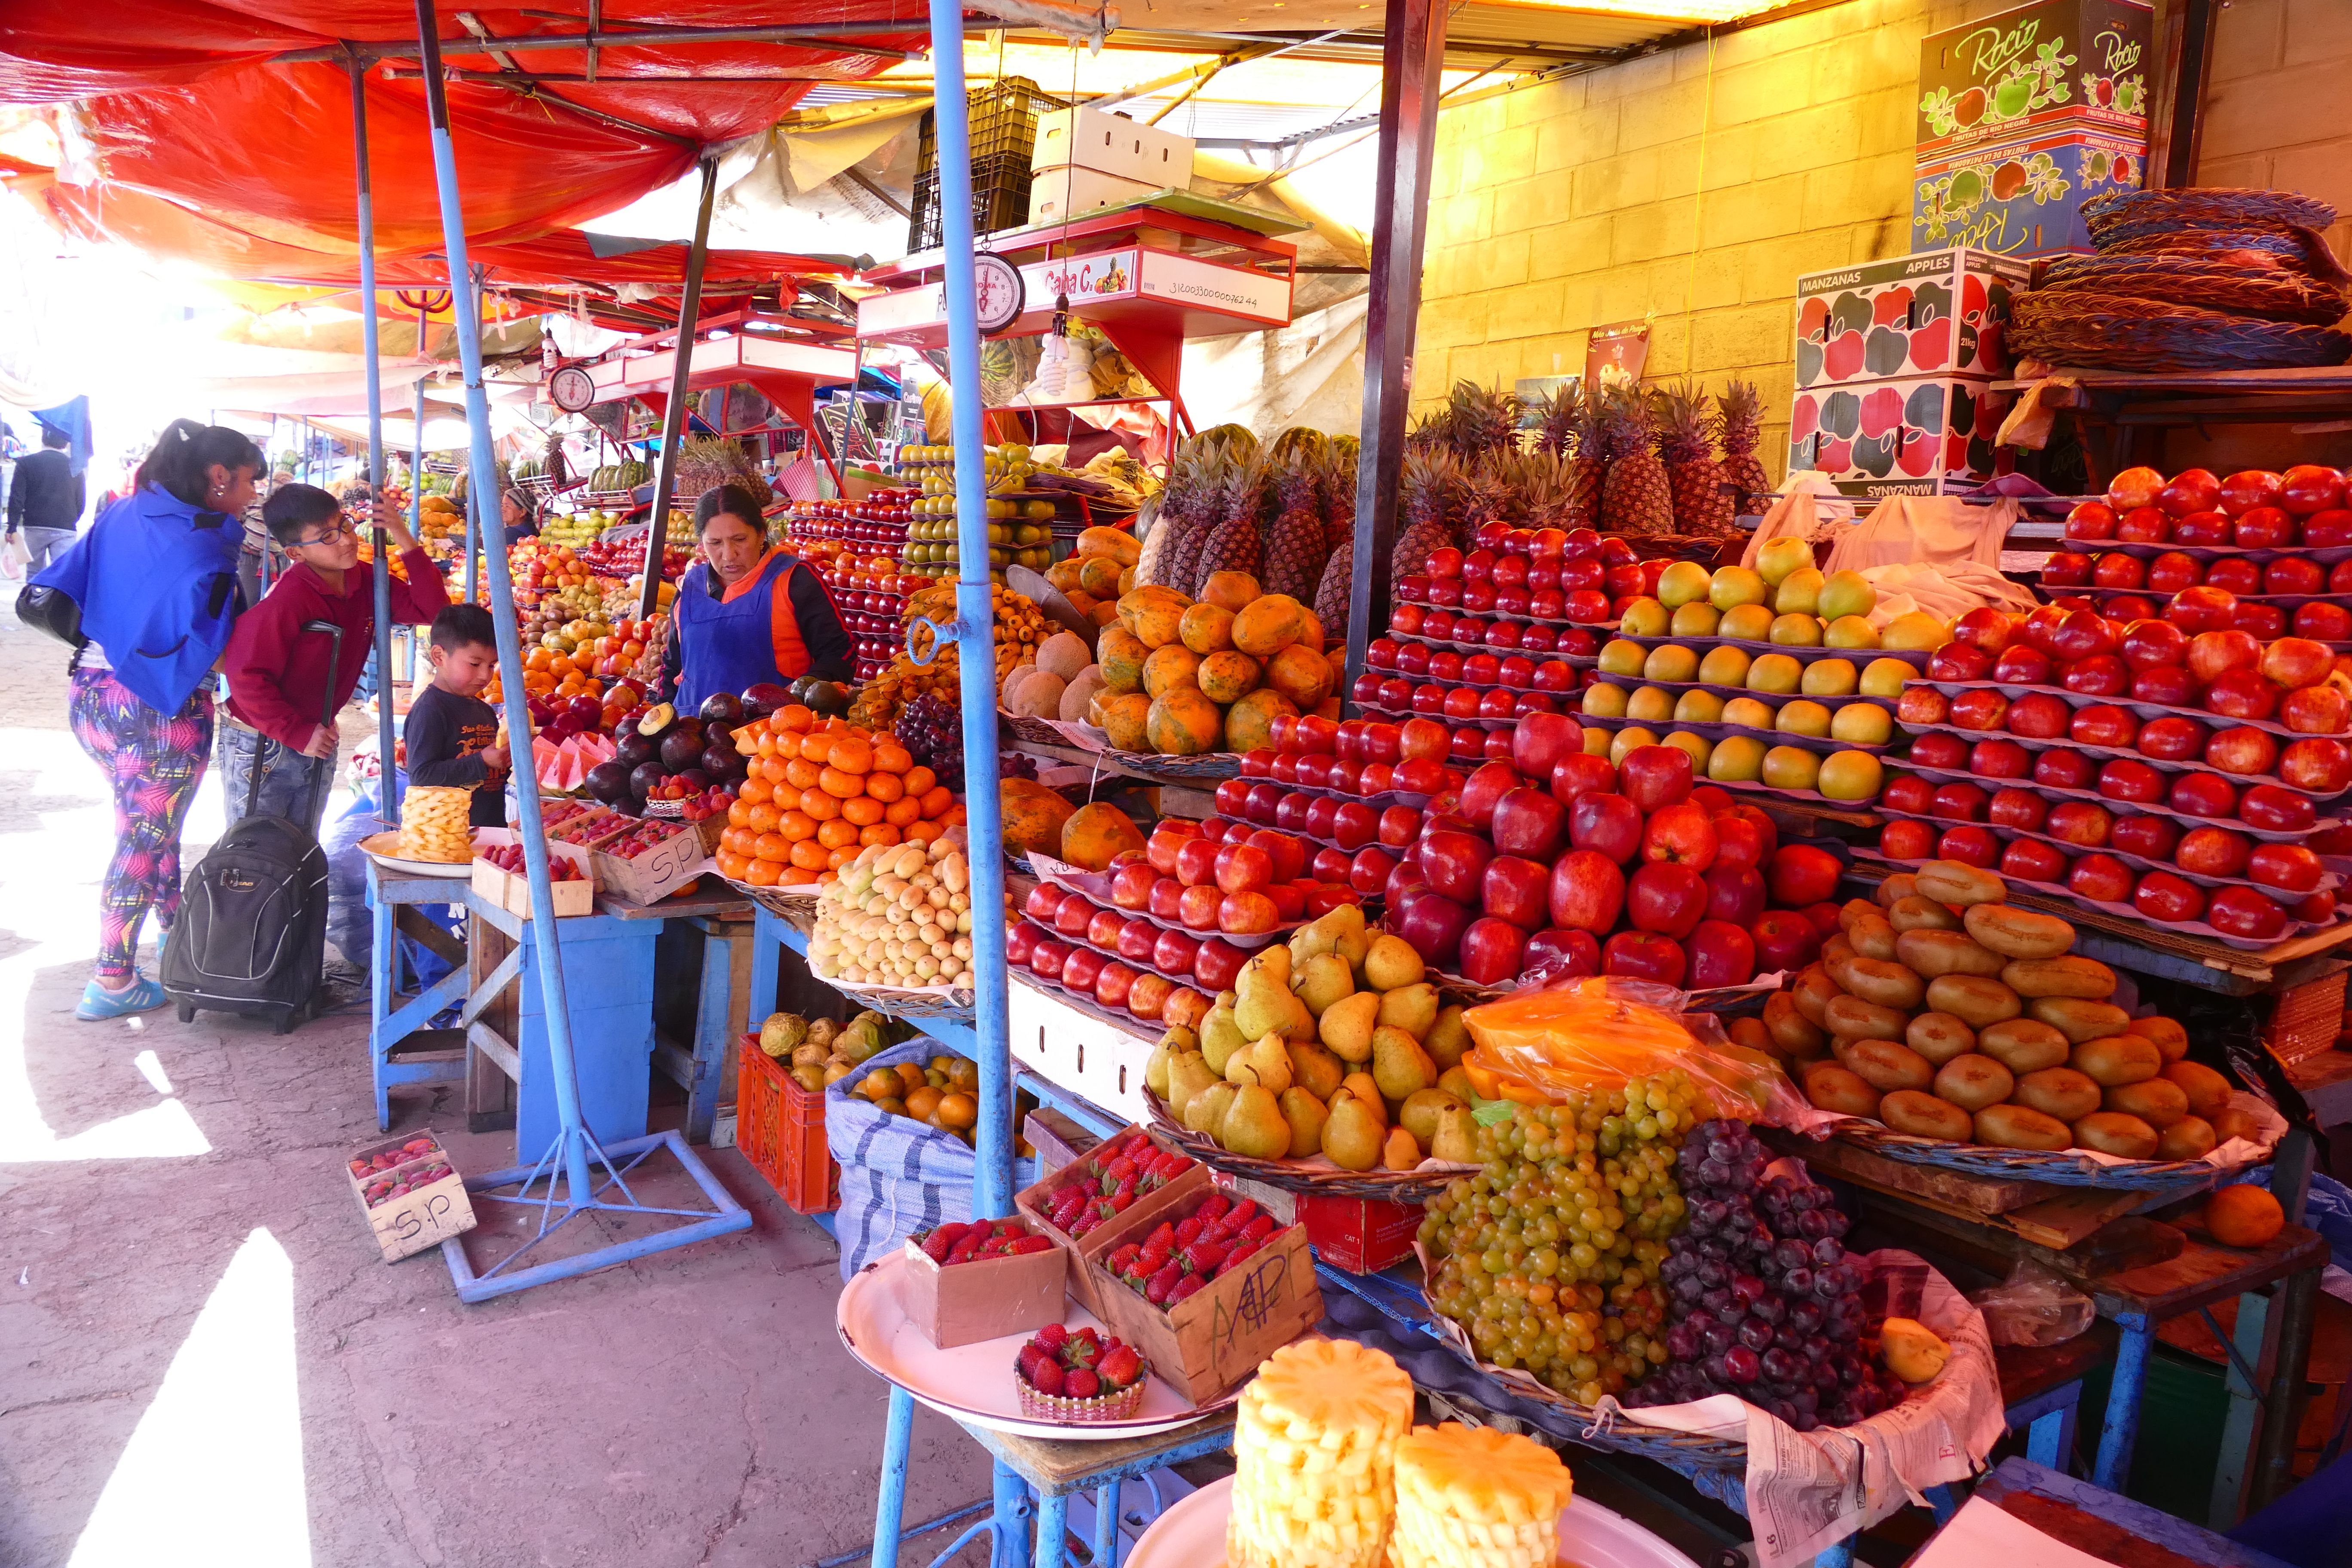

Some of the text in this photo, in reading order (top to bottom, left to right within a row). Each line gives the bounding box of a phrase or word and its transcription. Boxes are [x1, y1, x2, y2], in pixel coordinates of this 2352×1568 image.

[2086, 109, 2107, 118] FRUTAS
[2125, 117, 2140, 126] NEGRO
[1952, 132, 1977, 142] FRUTAS
[2004, 119, 2030, 130] NEGRO
[2085, 137, 2110, 148] PATAGONIA
[2003, 145, 2029, 157] FRUTAS
[2124, 144, 2141, 154] FRUTAS
[1948, 155, 1983, 170] PATAGONIA
[1966, 255, 1988, 263] MANZANAS
[1802, 257, 1950, 292] MANZANAS APPLES
[1960, 337, 1976, 349] 21kg
[1867, 484, 1932, 496] MANZANAS
[1345, 1234, 1356, 1243] CAT
